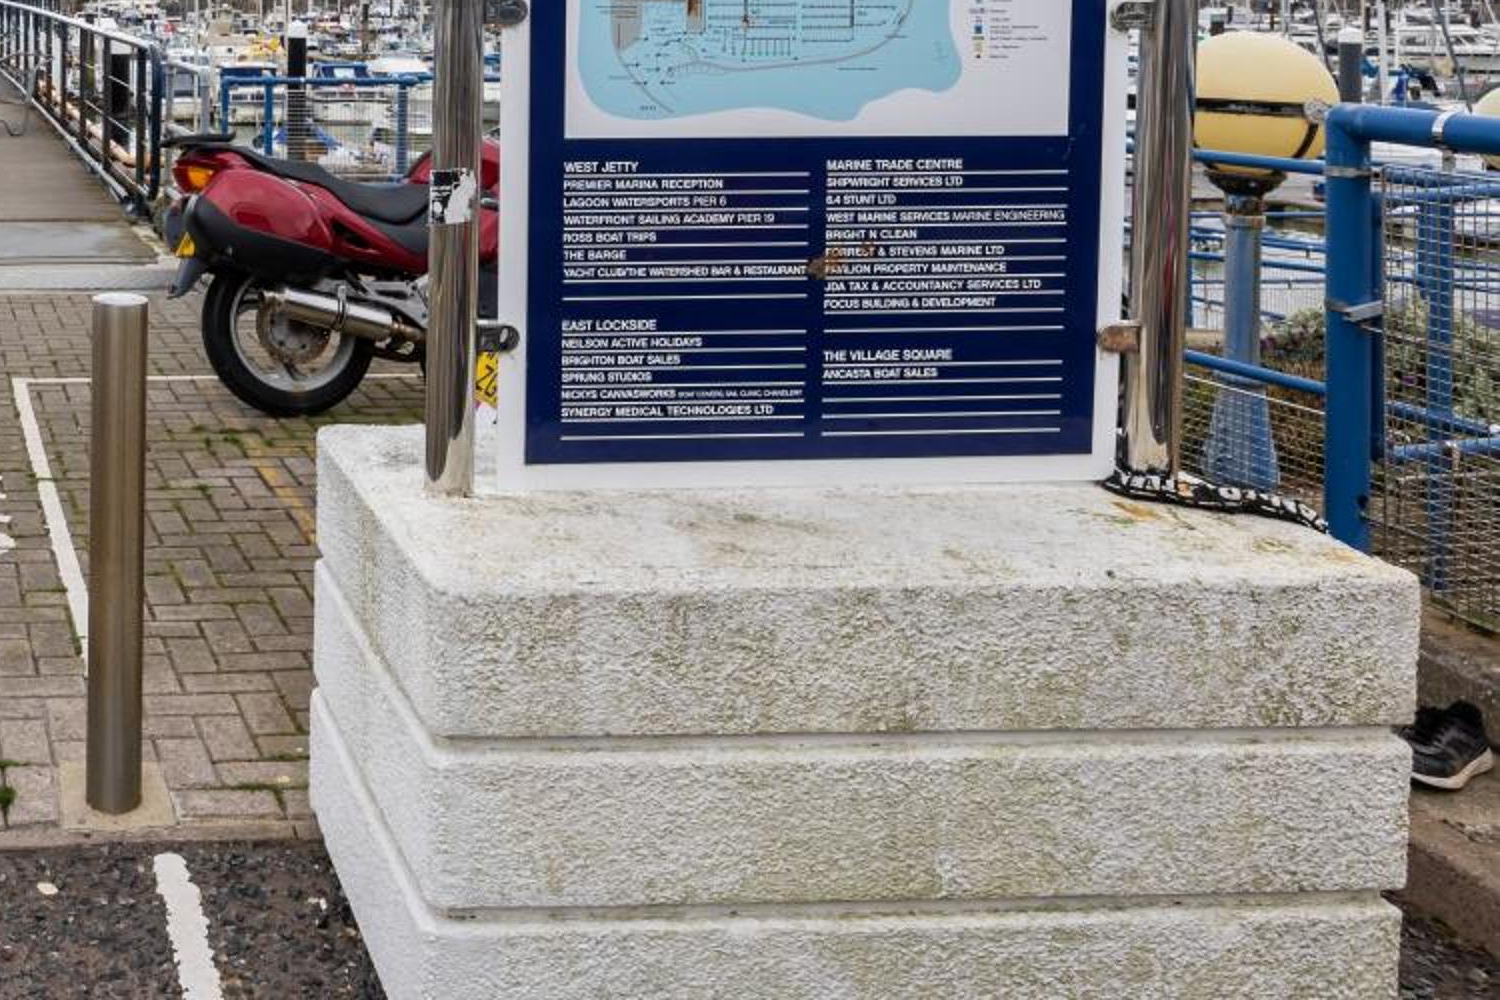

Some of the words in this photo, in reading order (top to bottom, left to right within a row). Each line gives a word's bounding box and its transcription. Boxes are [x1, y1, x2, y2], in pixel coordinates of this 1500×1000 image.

[564, 162, 599, 173] WEST
[602, 161, 638, 173] JETTY
[826, 160, 872, 170] MARINE
[875, 159, 914, 170] TRADE
[916, 159, 963, 169] CENTRE
[564, 180, 613, 190] PREMIER
[615, 179, 659, 190] MARINA
[661, 179, 724, 189] RECEPTION
[826, 177, 890, 188] SHIPWRIGHT
[892, 177, 943, 187] SERVICES
[945, 176, 963, 186] LTD
[564, 197, 609, 208] LAGOON
[612, 196, 691, 207] WATERSPORTS
[693, 196, 717, 207] PIER
[844, 195, 875, 205] STUNT
[877, 194, 896, 204] LTD
[564, 215, 635, 226] WATERFRONT
[637, 214, 680, 225] SAILING
[683, 214, 736, 224] ACADEMY
[738, 213, 761, 224] PIER
[826, 213, 855, 223] WEST
[858, 212, 897, 222] MARINE
[900, 211, 950, 222] SERVICES
[952, 211, 992, 221] MARINE
[994, 210, 1065, 221] ENGINEERING
[564, 232, 593, 243] ROSS
[596, 232, 624, 243] BOAT
[627, 231, 657, 242] TRIPS
[826, 230, 865, 240] BRIGHT
[880, 229, 917, 239] CLEAN
[564, 250, 584, 261] THE
[587, 250, 626, 260] BARGE
[826, 246, 875, 257] FORREST
[877, 246, 886, 256] &
[889, 246, 938, 256] STEVENS
[941, 245, 983, 256] MARINE
[985, 245, 1004, 255] LTD
[564, 267, 595, 278] YACHT
[649, 266, 709, 277] WATERSHED
[711, 266, 732, 276] BAR
[734, 266, 741, 276] &
[743, 265, 807, 276] RESTAURANT
[873, 263, 928, 274] PROPERTY
[931, 262, 1007, 273] MAINTENANCE
[849, 281, 868, 291] TAX
[871, 280, 879, 291] &
[882, 280, 964, 290] ACCOUNTANCY
[966, 279, 1019, 289] SERVICES
[1022, 278, 1042, 289] LTD
[824, 297, 859, 309] FOCUS
[862, 296, 910, 309] BUILDING
[911, 297, 919, 308] &
[921, 295, 996, 308] DEVELOPMENT
[562, 320, 593, 331] EAST
[596, 319, 658, 331] LOCKSIDE
[562, 338, 608, 349] NEILSON
[611, 338, 648, 348] ACTIVE
[650, 337, 703, 347] HOLIDAYS
[562, 355, 615, 366] BRIGHTON
[617, 355, 644, 365] BOAT
[647, 354, 681, 365] SALES
[824, 351, 847, 362] THE
[849, 350, 899, 361] VILLAGE
[903, 349, 952, 360] SQUARE
[607, 372, 653, 382] STUDIOS
[823, 369, 871, 379] ANCASTA
[874, 369, 900, 378] BOAT
[903, 368, 938, 378] SALES
[562, 389, 597, 400] NICKYS
[600, 389, 676, 399] CANVASWORKS
[561, 407, 613, 417] SYNERGY
[616, 406, 664, 417] MEDICAL
[667, 405, 752, 416] TECHNOLOGIES
[754, 405, 774, 415] LTD
